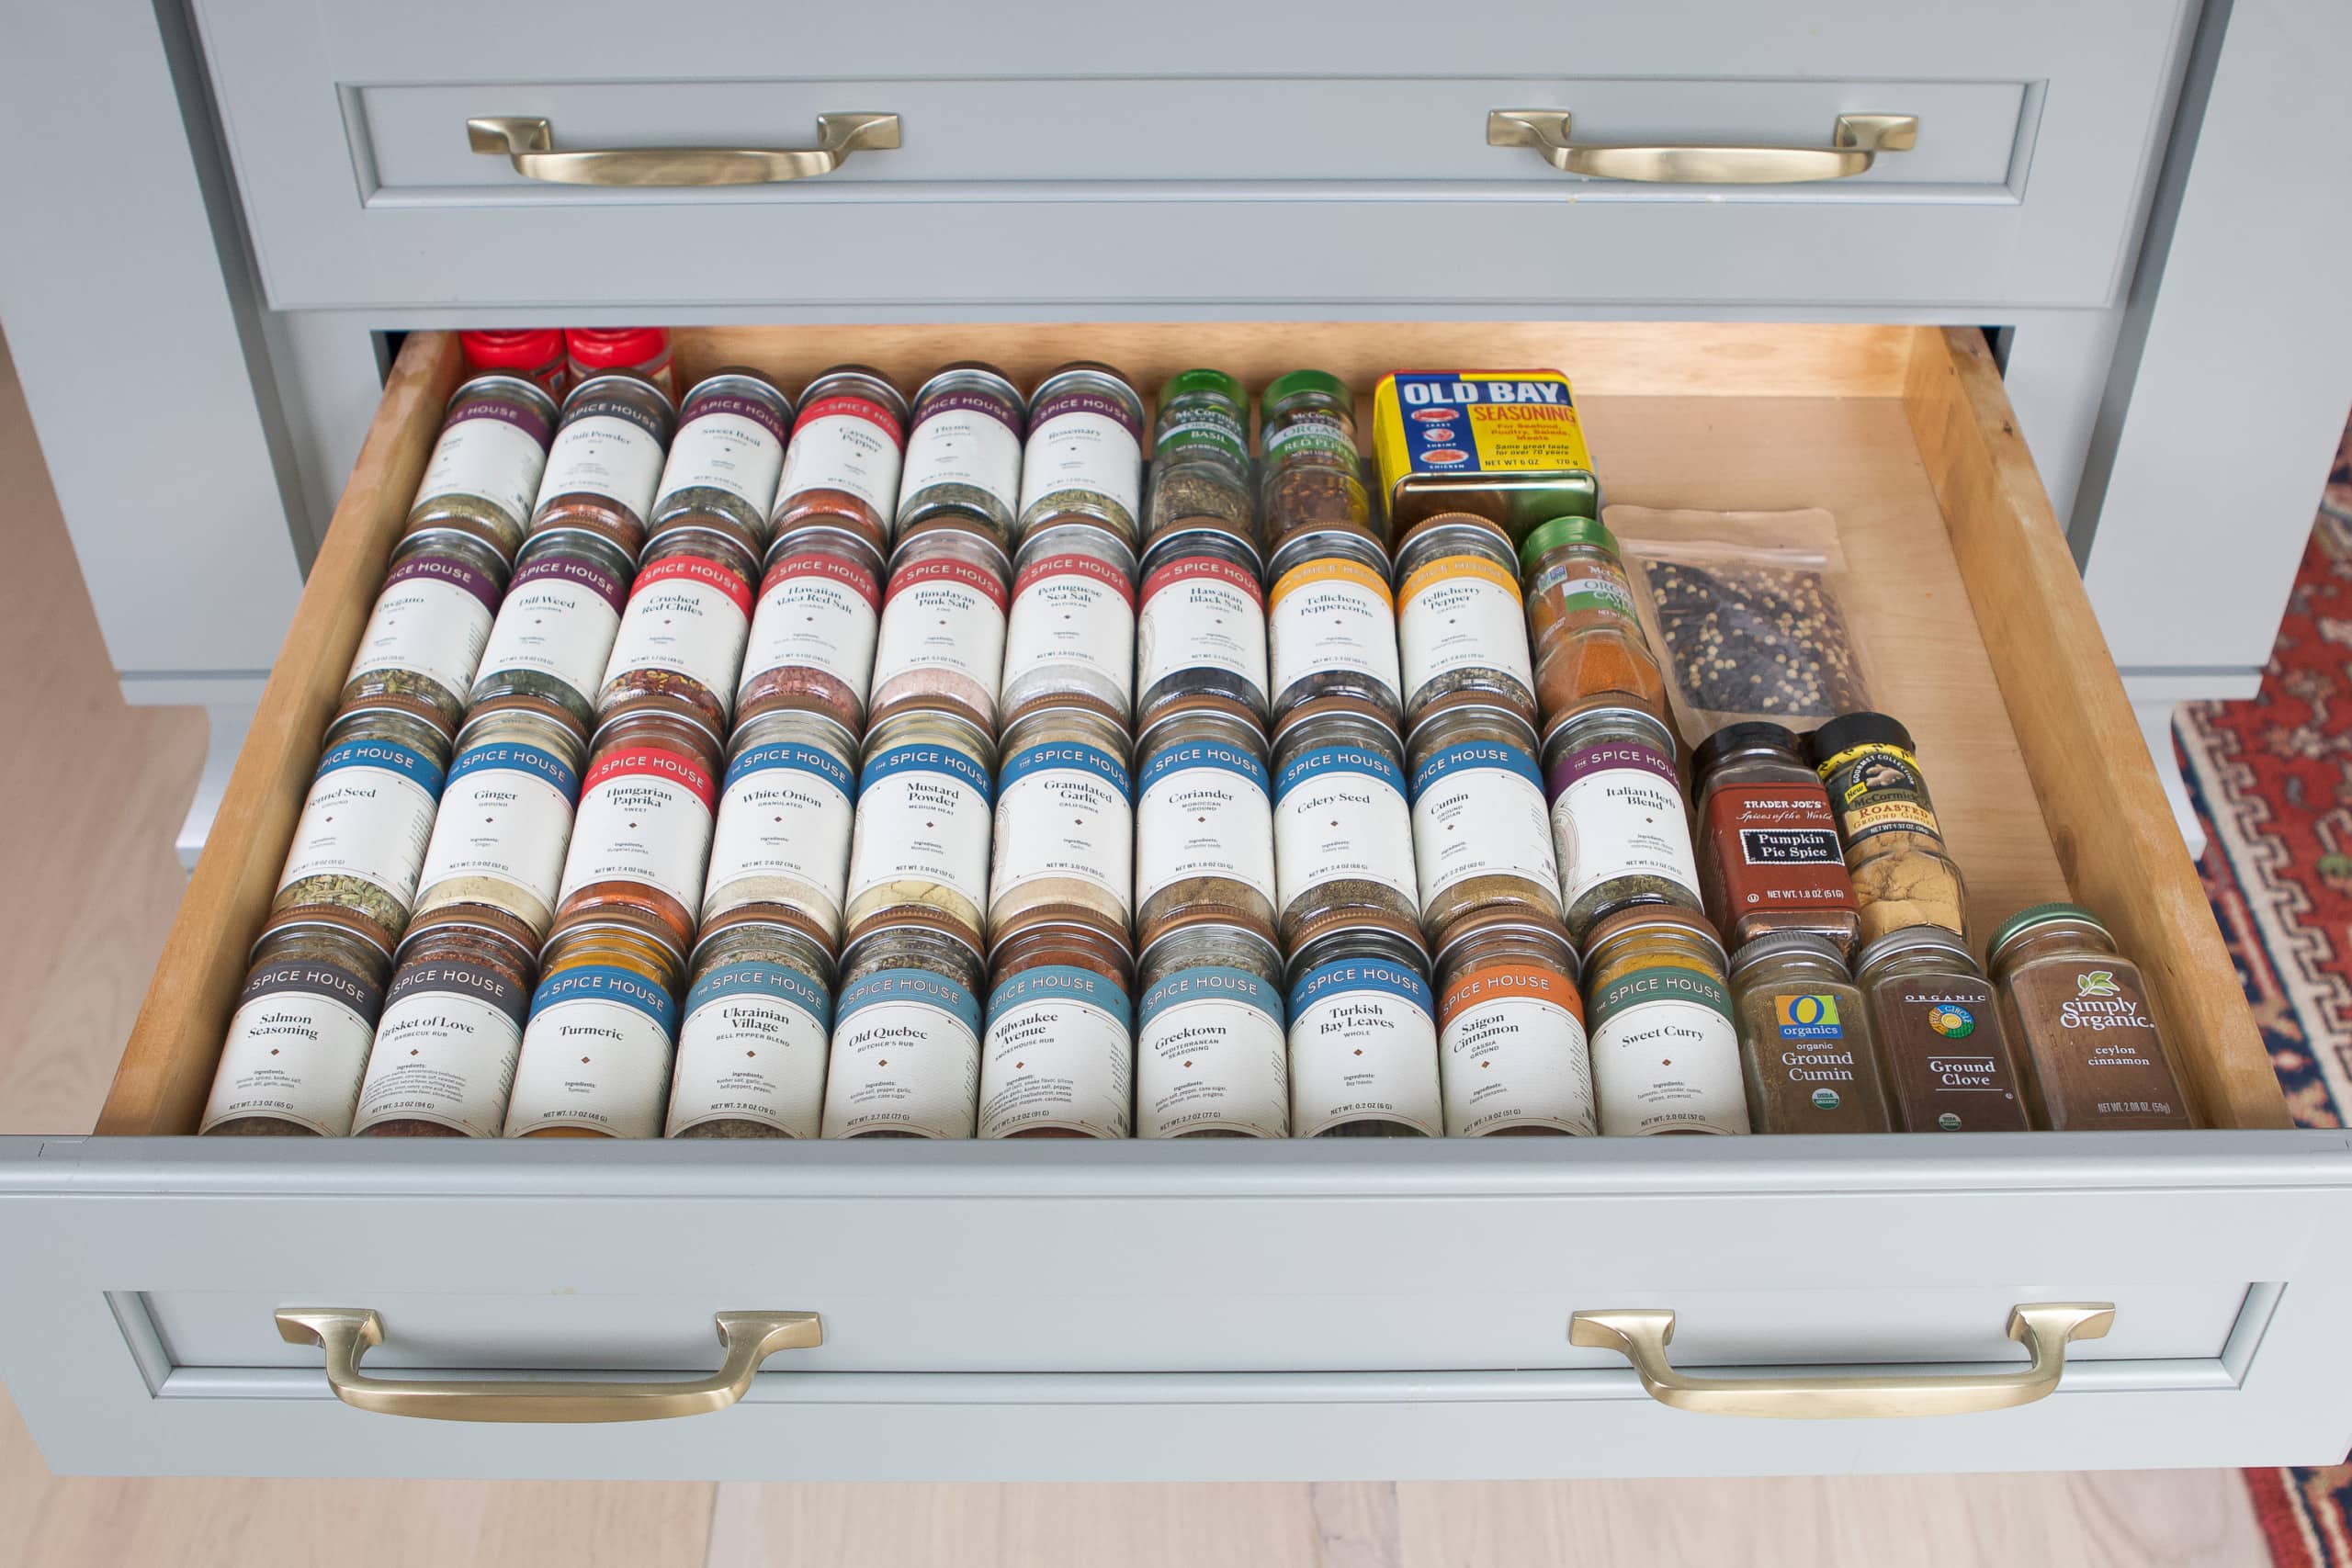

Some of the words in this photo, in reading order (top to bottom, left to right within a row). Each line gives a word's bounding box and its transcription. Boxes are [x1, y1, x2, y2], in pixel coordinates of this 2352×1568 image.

[1404, 382, 1478, 405] OLD
[1488, 382, 1562, 405] BAY
[921, 397, 958, 420] SPICE
[962, 398, 1011, 422] HOUSE
[1041, 400, 1079, 420] SPICE
[1083, 400, 1129, 423] HOUSE
[1474, 406, 1576, 426] SEASONING
[1192, 430, 1228, 444] BASIL
[1523, 444, 1546, 452] great
[419, 561, 472, 583] HOUSE
[520, 563, 560, 582] SPICE
[565, 564, 615, 595] HOUSE
[643, 562, 685, 582] SPICE
[691, 564, 740, 594] HOUSE
[779, 559, 823, 581] SPICE
[829, 563, 874, 595] HOUSE
[1030, 558, 1073, 581] SPICE
[1079, 559, 1125, 588] HOUSE
[1173, 562, 1221, 577] SPICE
[906, 564, 952, 583] SPICE
[956, 566, 1001, 598] HOUSE
[650, 594, 700, 606] Crushed
[787, 586, 843, 603] Hawaiian
[915, 590, 976, 608] Himalayan
[1037, 585, 1102, 600] Portuguese
[1070, 592, 1092, 608] Salt
[1190, 595, 1223, 607] Black
[1191, 587, 1243, 606] Hawaiian
[1306, 594, 1367, 609] Tellicherry
[668, 600, 705, 617] Chiles
[832, 599, 854, 615] Salt
[919, 599, 946, 607] Pink
[948, 597, 970, 612] Salt
[1301, 605, 1374, 619] Peppercorns
[1430, 596, 1472, 611] Pepper
[356, 746, 414, 770] HOUSE
[462, 749, 508, 768] SPICE
[514, 750, 568, 783] HOUSE
[743, 749, 791, 768] SPICE
[796, 750, 845, 784] HOUSE
[1155, 748, 1202, 772] SPICE
[1207, 750, 1259, 776] HOUSE
[1591, 750, 1641, 764] SPICE
[601, 758, 648, 778] SPICE
[653, 759, 704, 793] HOUSE
[889, 750, 939, 768] SPICE
[944, 755, 989, 793] HOUSE
[1035, 749, 1085, 766] SPICE
[1091, 752, 1131, 793] HOUSE
[1287, 752, 1332, 782] SPICE
[1338, 753, 1392, 777] HOUSE
[1414, 758, 1446, 793] SPICE
[1451, 750, 1509, 766] HOUSE
[345, 787, 378, 803] Seed
[475, 789, 519, 804] Ginger
[606, 786, 673, 802] Hungarian
[744, 790, 779, 803] White
[782, 789, 823, 808] Onion
[908, 783, 960, 799] Mustard
[909, 792, 956, 809] Powder
[1045, 780, 1114, 804] Granulated
[1060, 790, 1099, 807] Garlic
[1169, 789, 1235, 806] Coriander
[1606, 787, 1645, 801] Italian
[613, 795, 662, 809] Paprika
[1297, 793, 1337, 815] Celery
[1340, 788, 1371, 805] Seed
[1431, 793, 1469, 817] Cumin
[1626, 795, 1663, 810] Blend
[1744, 800, 1791, 809] TRADER
[1792, 800, 1822, 809] JOE'S
[1860, 805, 1928, 824] ROASTED
[1758, 833, 1825, 852] Pumpkin
[1761, 847, 1786, 861] Pie
[1790, 847, 1828, 862] Spice
[1767, 890, 1784, 899] NET
[1785, 890, 1799, 899] WT.
[1801, 890, 1812, 898] 1.8
[1814, 889, 1824, 898] OZ
[252, 970, 300, 991] SPICE
[306, 972, 366, 1004] HOUSE
[392, 969, 436, 998] SPICE
[443, 970, 505, 998] HOUSE
[1308, 969, 1357, 995] SPICE
[1363, 967, 1420, 995] HOUSE
[1610, 977, 1659, 1004] SPICE
[1667, 976, 1723, 1004] HOUSE
[550, 976, 603, 996] SPICE
[609, 978, 665, 1012] HOUSE
[711, 972, 764, 991] SPICE
[771, 974, 824, 1010] HOUSE
[847, 978, 893, 1006] SPICE
[899, 978, 961, 1006] HOUSE
[989, 980, 1026, 1016] SPICE
[1032, 976, 1096, 994] HOUSE
[1147, 979, 1189, 1010] SPICE
[1196, 976, 1258, 996] HOUSE
[1442, 983, 1481, 1016] SPICE
[1487, 974, 1551, 992] HOUSE
[723, 1007, 791, 1025] Ukrainian
[1329, 1003, 1385, 1020] Turkish
[2062, 997, 2137, 1017] Simply
[261, 1011, 313, 1027] Salmon
[731, 1018, 780, 1034] Village
[995, 1013, 1060, 1043] Milwaukee
[1321, 1020, 1346, 1036] Bay
[1348, 1017, 1396, 1031] Leaves
[1462, 1012, 1506, 1036] Saigon
[248, 1024, 321, 1043] Seasoning
[382, 1019, 421, 1042] Brisket
[424, 1019, 437, 1029] of
[441, 1018, 476, 1035] Love
[560, 1026, 625, 1043] Turmeric
[848, 1029, 873, 1047] Old
[875, 1026, 931, 1042] Quebec
[1001, 1026, 1047, 1048] Avenue
[1155, 1025, 1227, 1051] Greektown
[1344, 1031, 1372, 1040] WHOLE
[1453, 1024, 1520, 1055] Cinnamon
[1622, 1028, 1663, 1048] Sweet
[1664, 1024, 1707, 1043] Curry
[1783, 1024, 1838, 1038] organics
[1160, 1039, 1220, 1057] MEDITERRANEAN
[1796, 1042, 1834, 1052] organic
[2096, 1044, 2137, 1057] ceylon
[1781, 1050, 1854, 1067] Ground
[1929, 1060, 1997, 1075] Ground
[2087, 1056, 2151, 1067] cinnamon
[1789, 1067, 1854, 1082] Cumin
[1941, 1073, 1991, 1088] Clove
